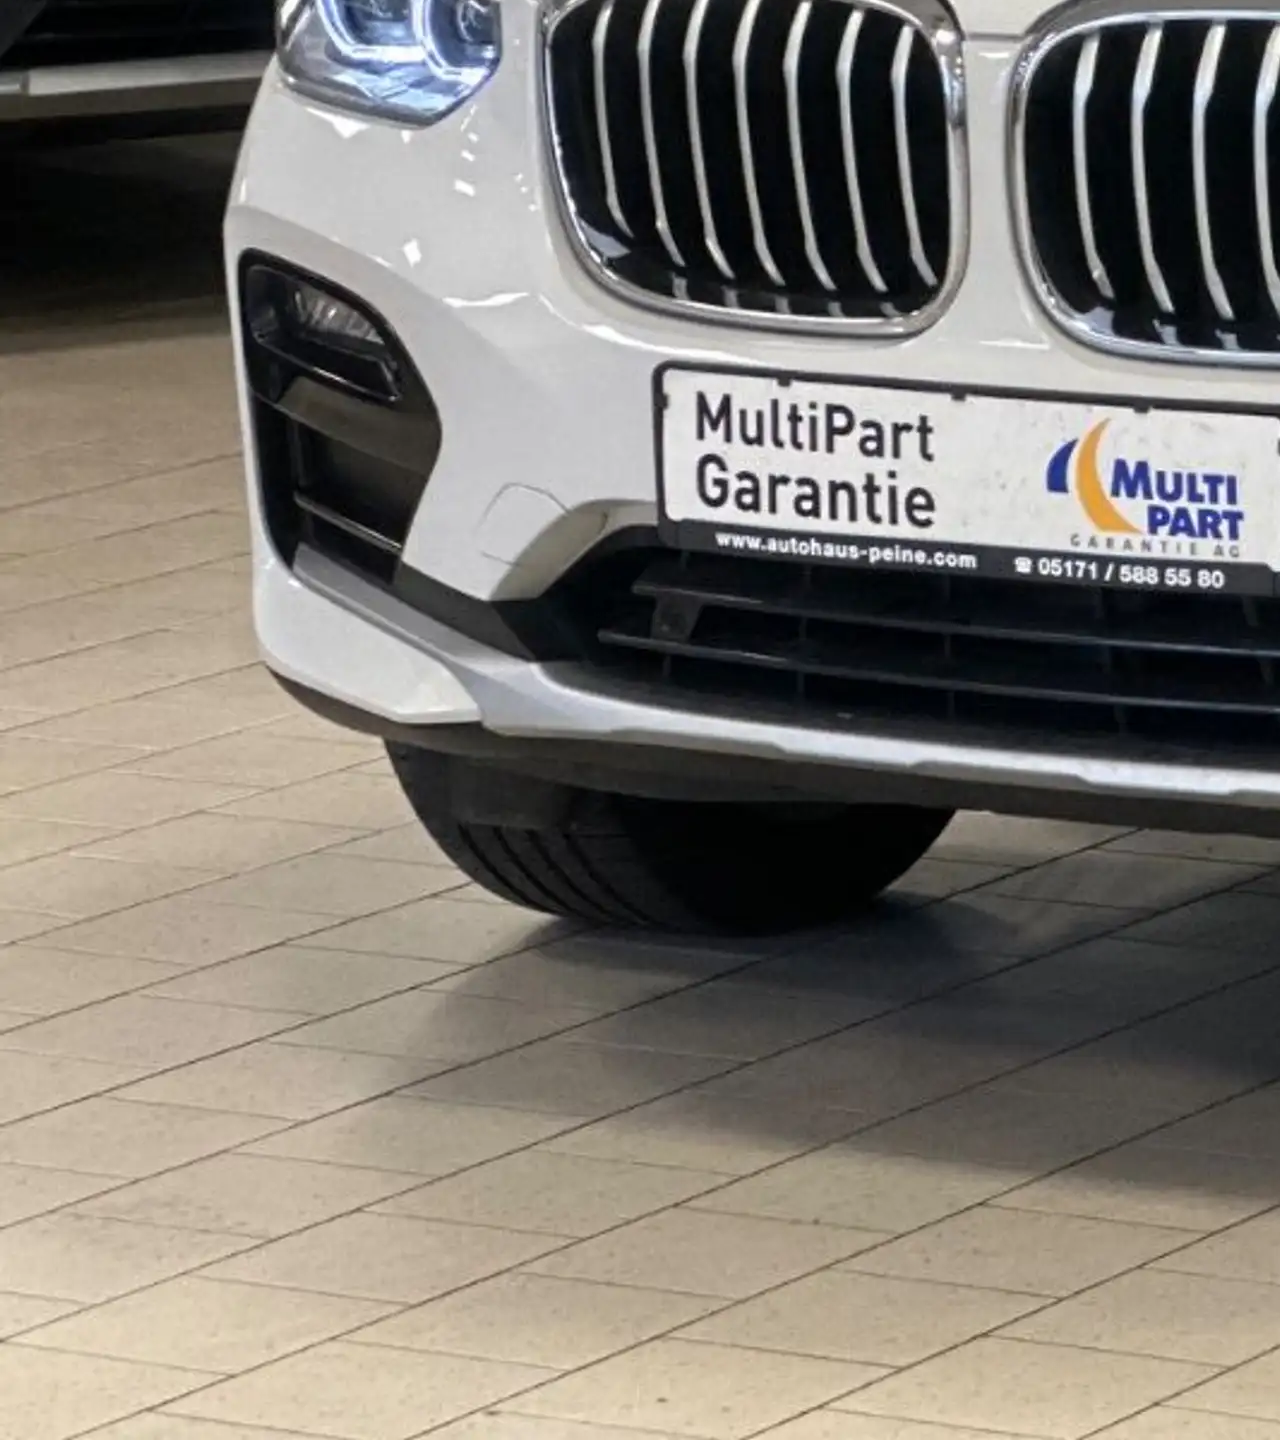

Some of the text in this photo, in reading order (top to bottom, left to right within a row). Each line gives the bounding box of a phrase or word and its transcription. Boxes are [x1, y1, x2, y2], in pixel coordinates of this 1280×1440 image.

[696, 390, 935, 462] MultiPart
[696, 453, 936, 528] Garantie
[1110, 458, 1237, 505] MULTI
[1070, 533, 1240, 558] GARANTIE AG
[1147, 505, 1245, 541] PART
[714, 531, 978, 569] www.autohaus-peine.com
[1038, 557, 1098, 580] 05171
[1119, 564, 1159, 585] 588
[1164, 567, 1192, 587] 55
[1197, 569, 1225, 589] 80
